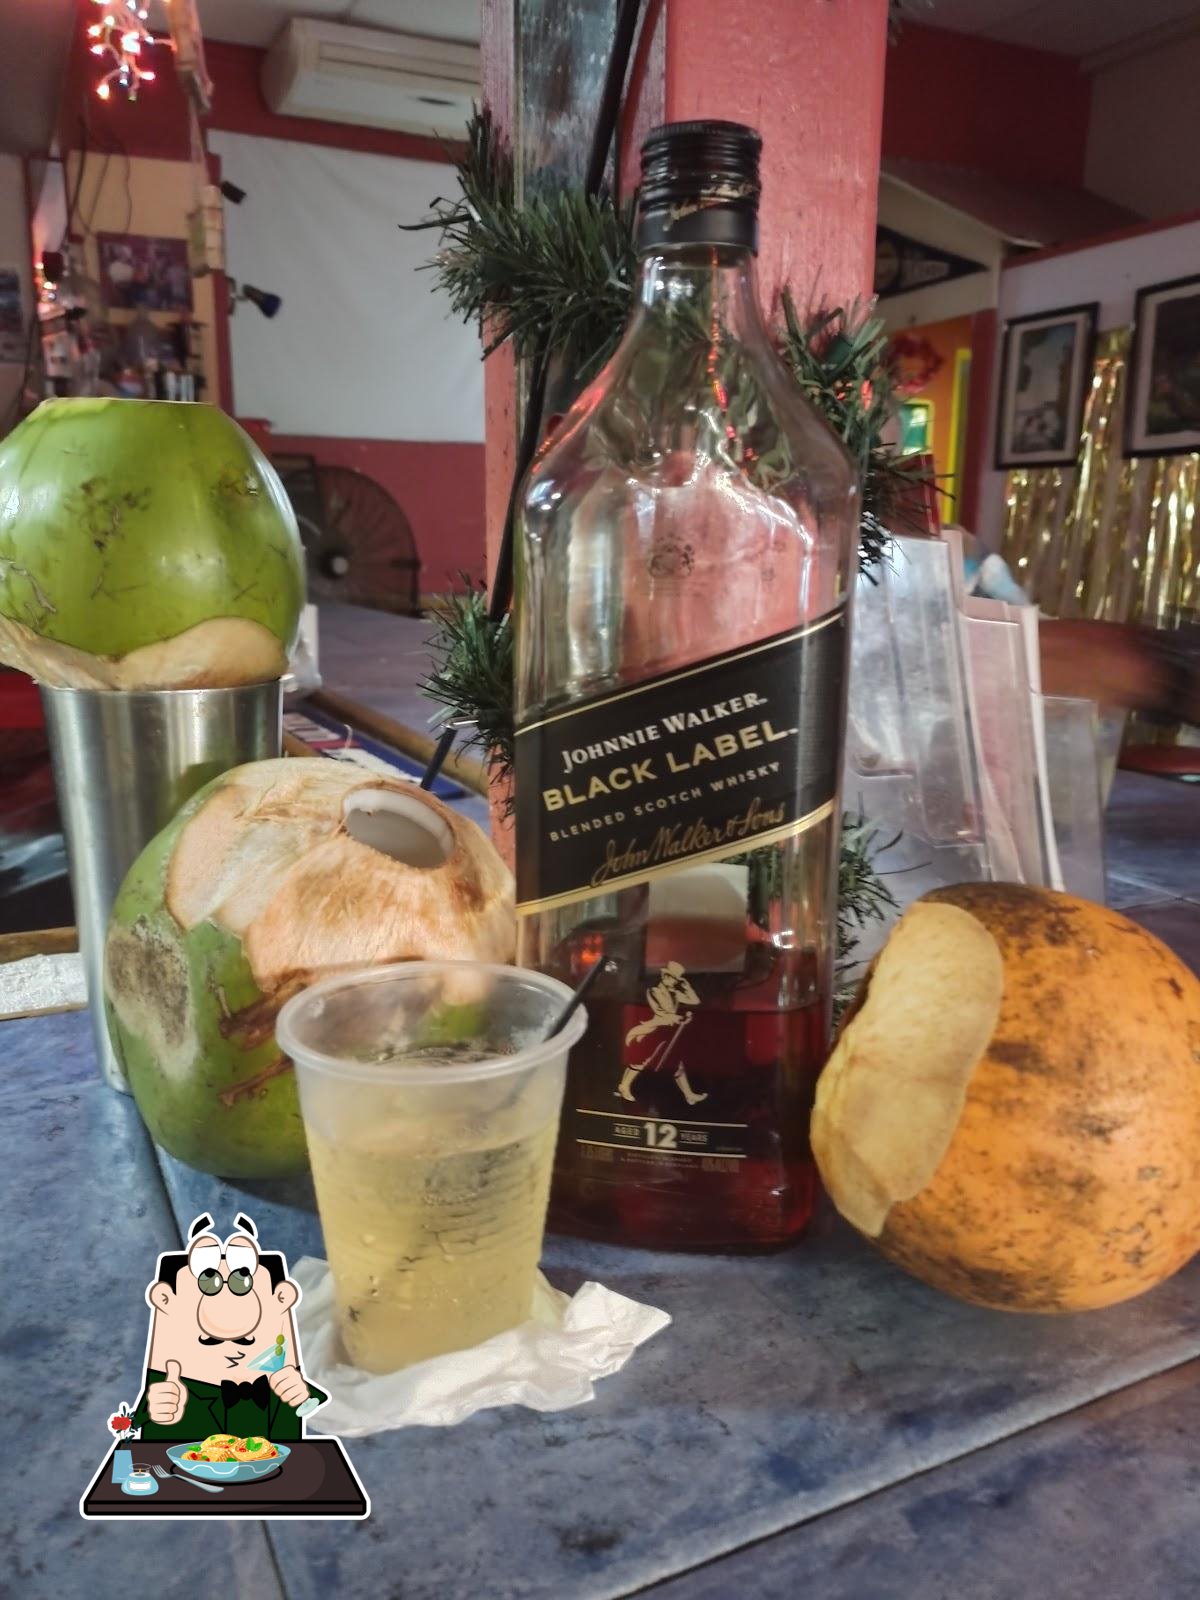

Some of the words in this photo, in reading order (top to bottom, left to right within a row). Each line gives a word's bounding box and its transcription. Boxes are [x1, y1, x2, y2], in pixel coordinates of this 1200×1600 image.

[543, 758, 657, 812] BLACK
[667, 720, 790, 774] LABEL
[561, 725, 660, 774] JOHNNIE
[549, 811, 626, 843] BLENDED
[634, 788, 703, 817] SCOTCH
[710, 761, 781, 793] WHISKY
[590, 839, 649, 888] John
[648, 816, 724, 861] Walker
[737, 797, 786, 835] Sons
[643, 1121, 678, 1149] 12
